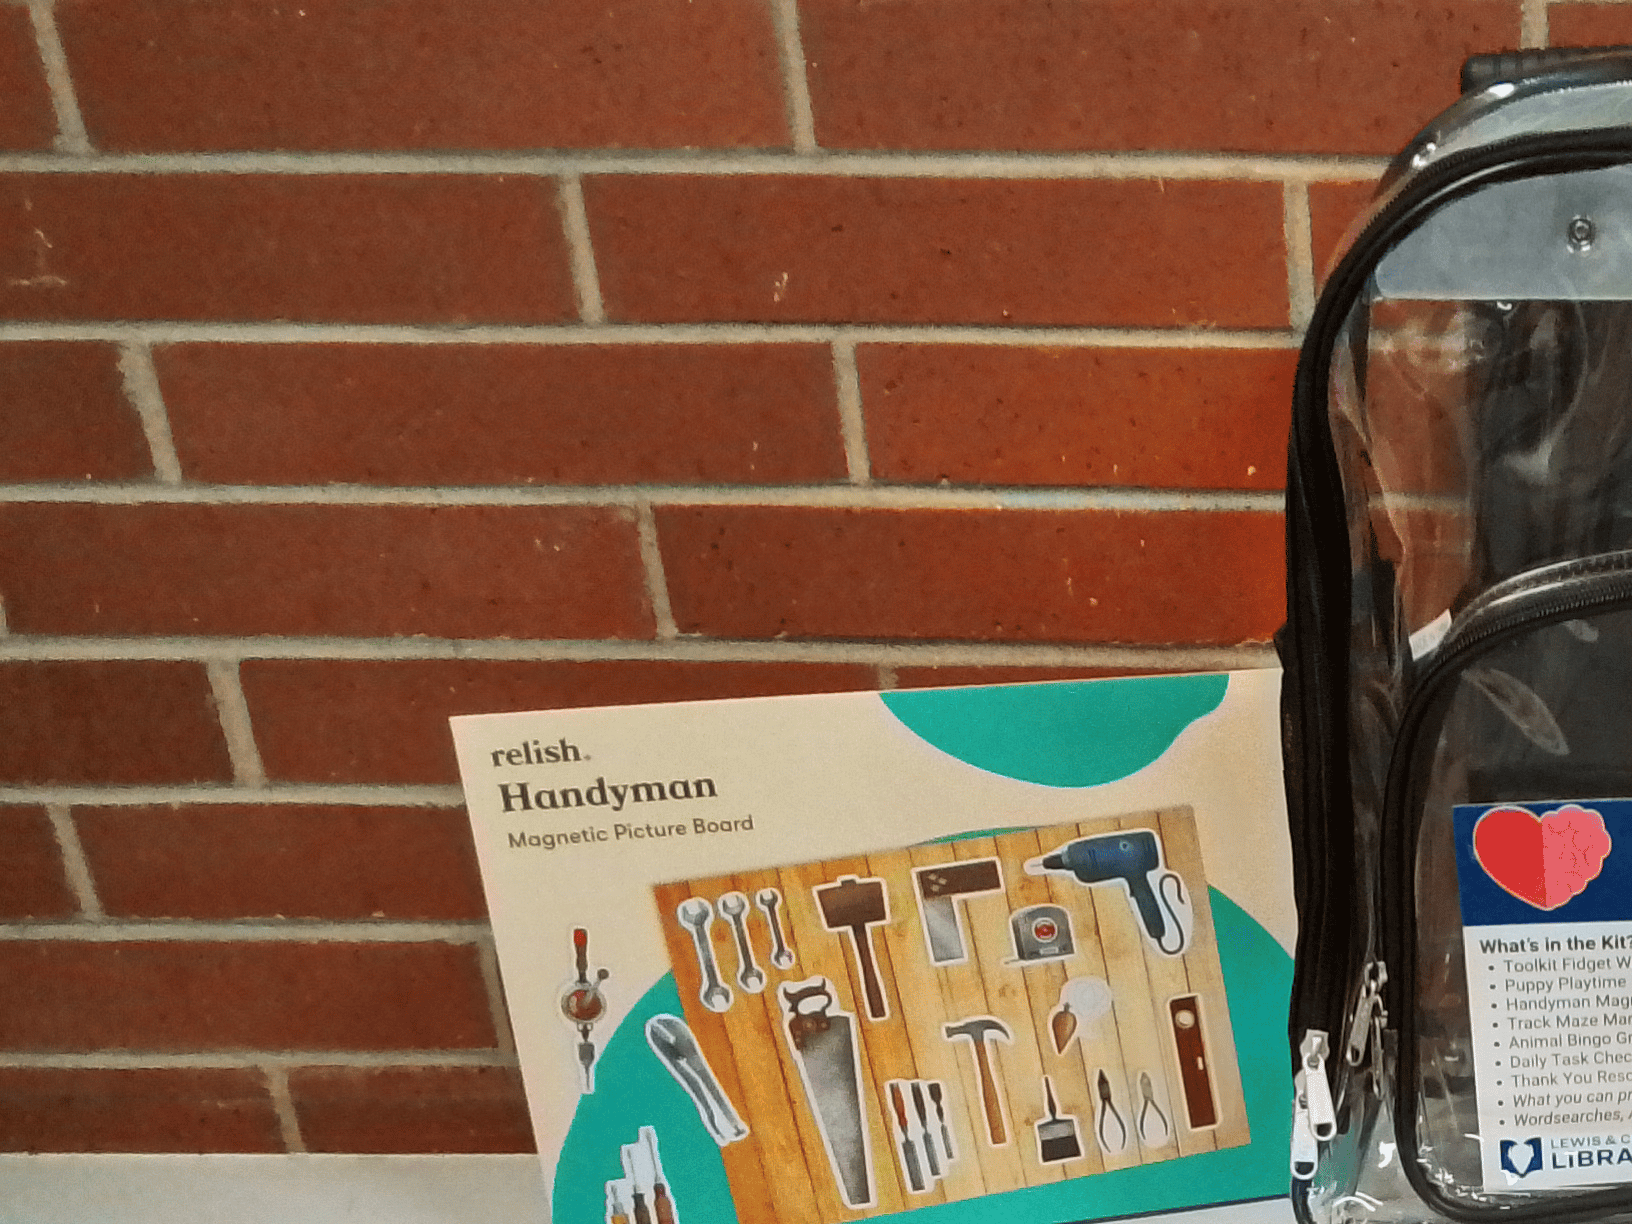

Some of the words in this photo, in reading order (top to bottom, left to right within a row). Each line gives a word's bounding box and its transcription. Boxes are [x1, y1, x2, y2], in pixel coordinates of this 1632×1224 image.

[498, 776, 718, 813] Handyman
[508, 826, 608, 850] Magnetic
[614, 821, 687, 840] Picture
[692, 814, 755, 834] Board
[1479, 937, 1539, 954] What's
[1545, 937, 1561, 951] in
[1566, 935, 1596, 950] the
[1503, 958, 1557, 973] Toolkit
[1562, 957, 1611, 973] Fidget
[1505, 978, 1553, 994] Puppy
[1558, 976, 1626, 992] Playtime
[1506, 996, 1590, 1012] Handyman
[1507, 1015, 1551, 1030] Track
[1556, 1014, 1598, 1029] Maze
[1509, 1034, 1562, 1049] Animal
[1567, 1033, 1611, 1048] Bingo
[1510, 1054, 1546, 1069] Daily
[1552, 1052, 1588, 1066] Task
[1511, 1073, 1558, 1088] Thank
[1563, 1072, 1592, 1085] You
[1513, 1093, 1551, 1108] What
[1555, 1093, 1582, 1108] you
[1586, 1092, 1613, 1102] can
[1514, 1107, 1624, 1127] Wordsearches,
[1550, 1136, 1601, 1150] LEWIS
[1605, 1135, 1616, 1145] &
